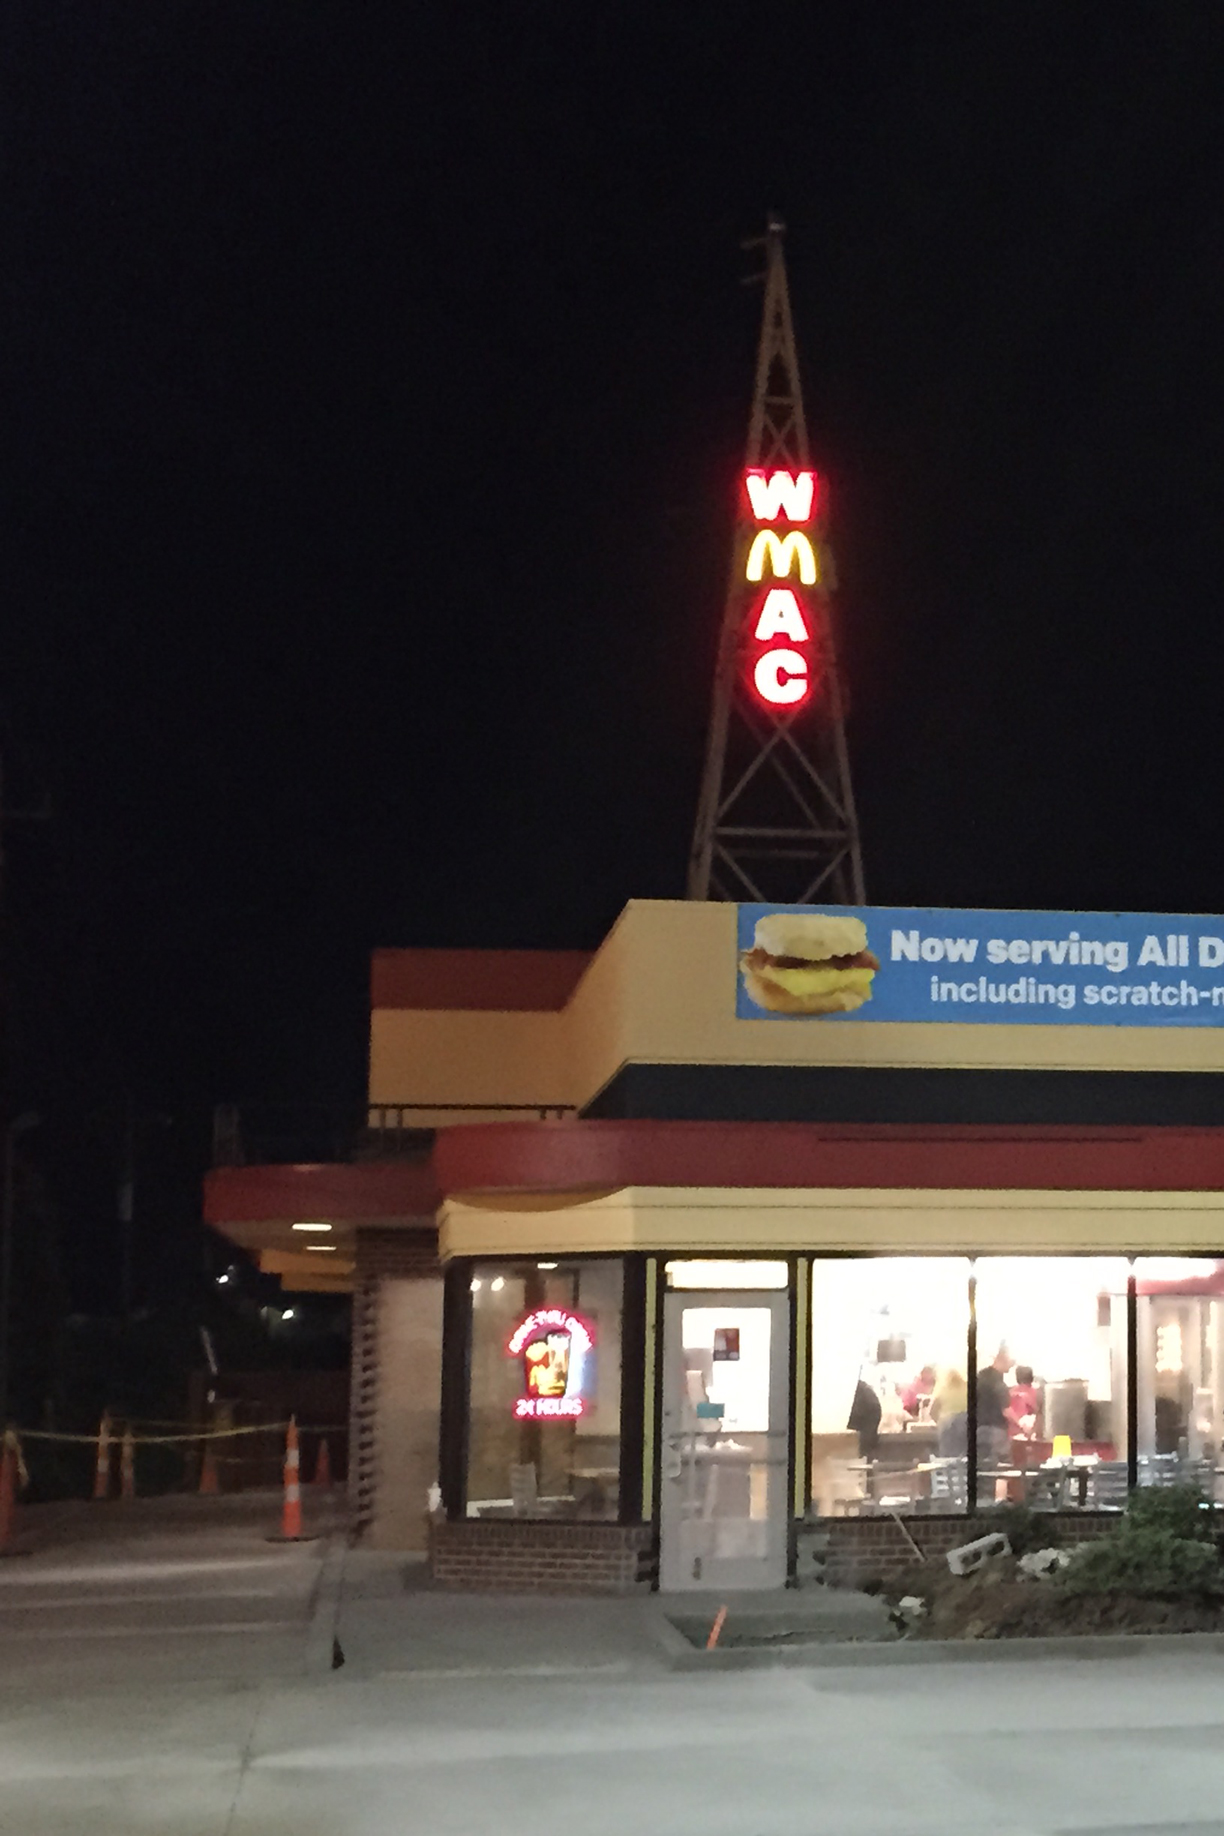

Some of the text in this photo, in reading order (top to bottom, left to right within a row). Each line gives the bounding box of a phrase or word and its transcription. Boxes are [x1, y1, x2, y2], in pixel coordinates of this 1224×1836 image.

[890, 929, 978, 963] Now
[986, 931, 1128, 972] serving
[1137, 934, 1189, 968] All
[930, 975, 1076, 1009] including
